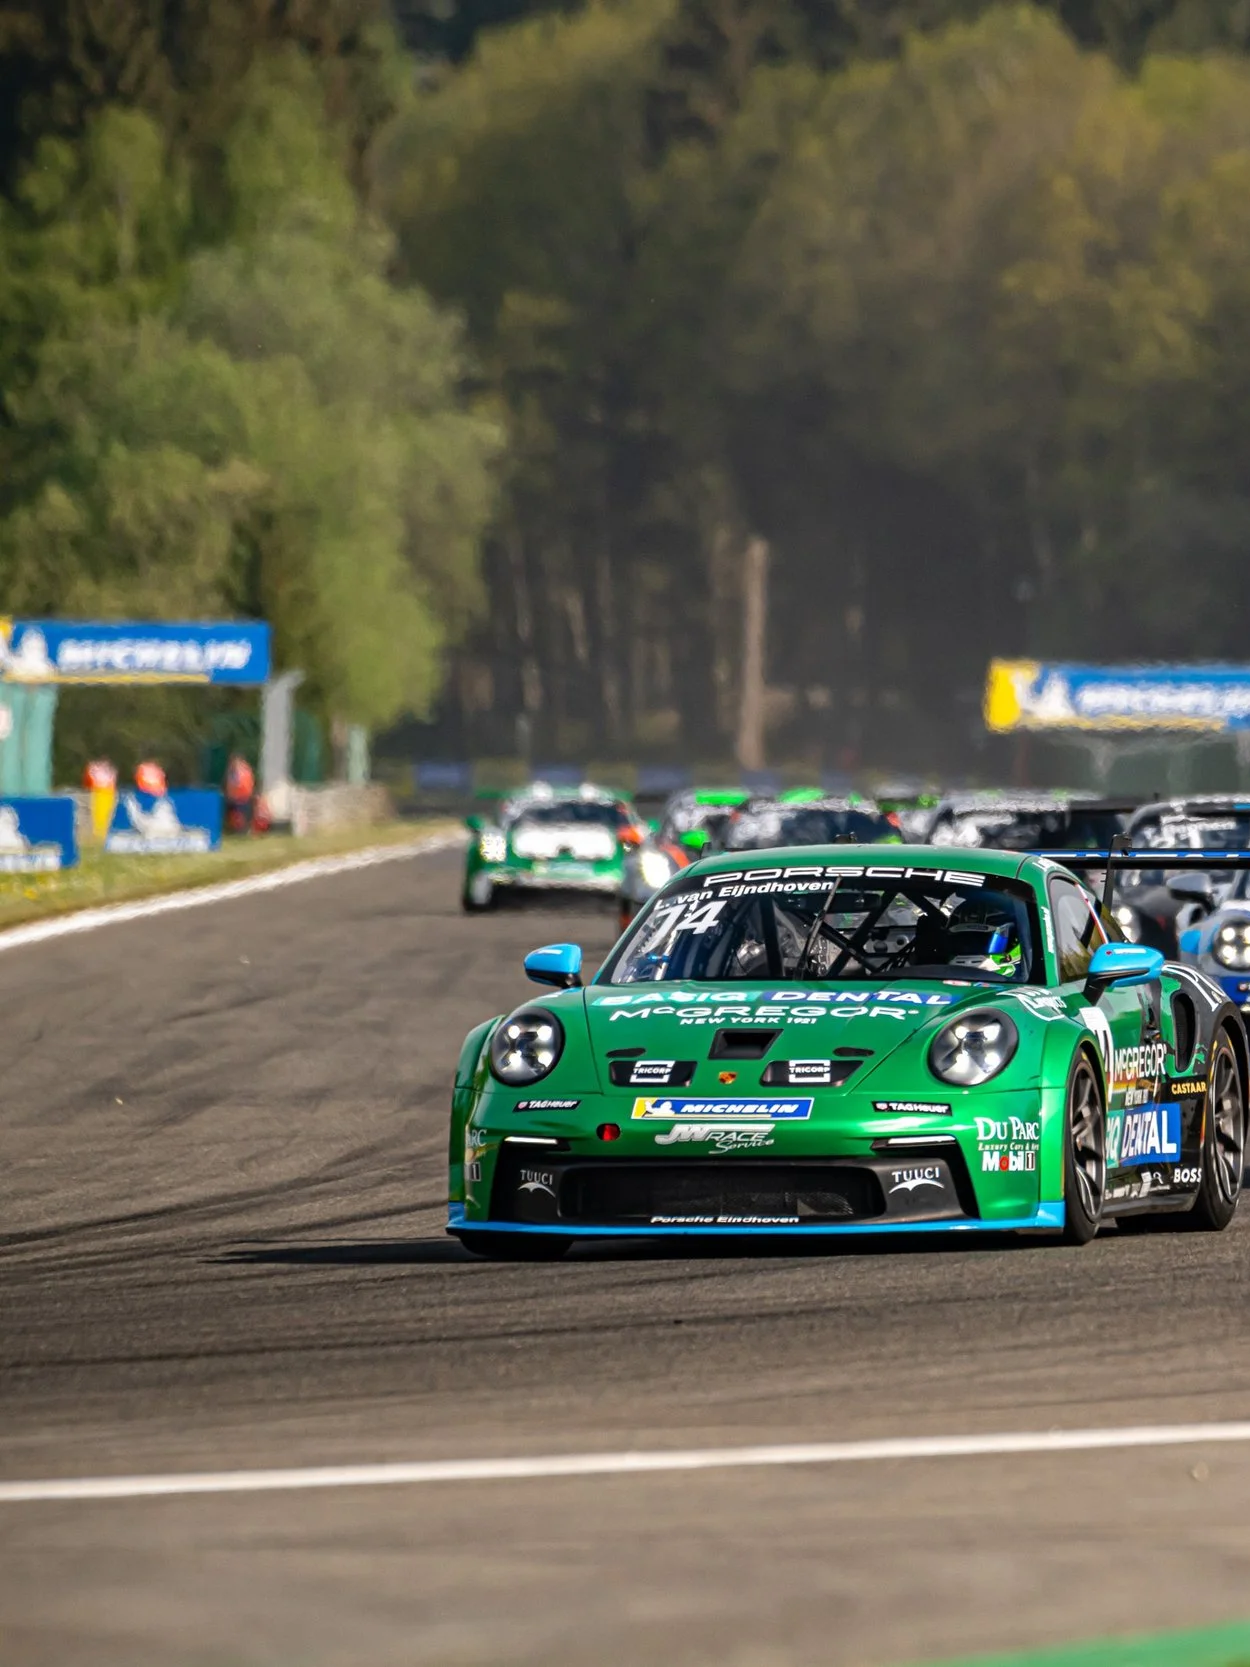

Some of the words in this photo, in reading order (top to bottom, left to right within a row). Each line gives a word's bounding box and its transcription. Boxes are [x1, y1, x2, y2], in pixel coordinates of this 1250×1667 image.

[704, 867, 985, 887] PORSCHE
[677, 890, 713, 905] van
[718, 881, 835, 897] Eijndhoven
[600, 991, 748, 1005] BASIQ
[771, 990, 952, 1005] DENTAL
[633, 1067, 672, 1075] TRICORP
[789, 1066, 831, 1074] TRICORP
[1171, 1081, 1207, 1095] CASTAAR
[681, 1104, 800, 1113] MICHELIN
[1120, 1110, 1177, 1158] DENTAL
[708, 1138, 775, 1154] Service
[981, 1151, 1025, 1172] Mobil
[520, 1169, 554, 1185] TUUCI
[891, 1167, 941, 1183] TUUCI
[651, 1216, 713, 1224] Porsche
[716, 1216, 799, 1224] Eindhoven
